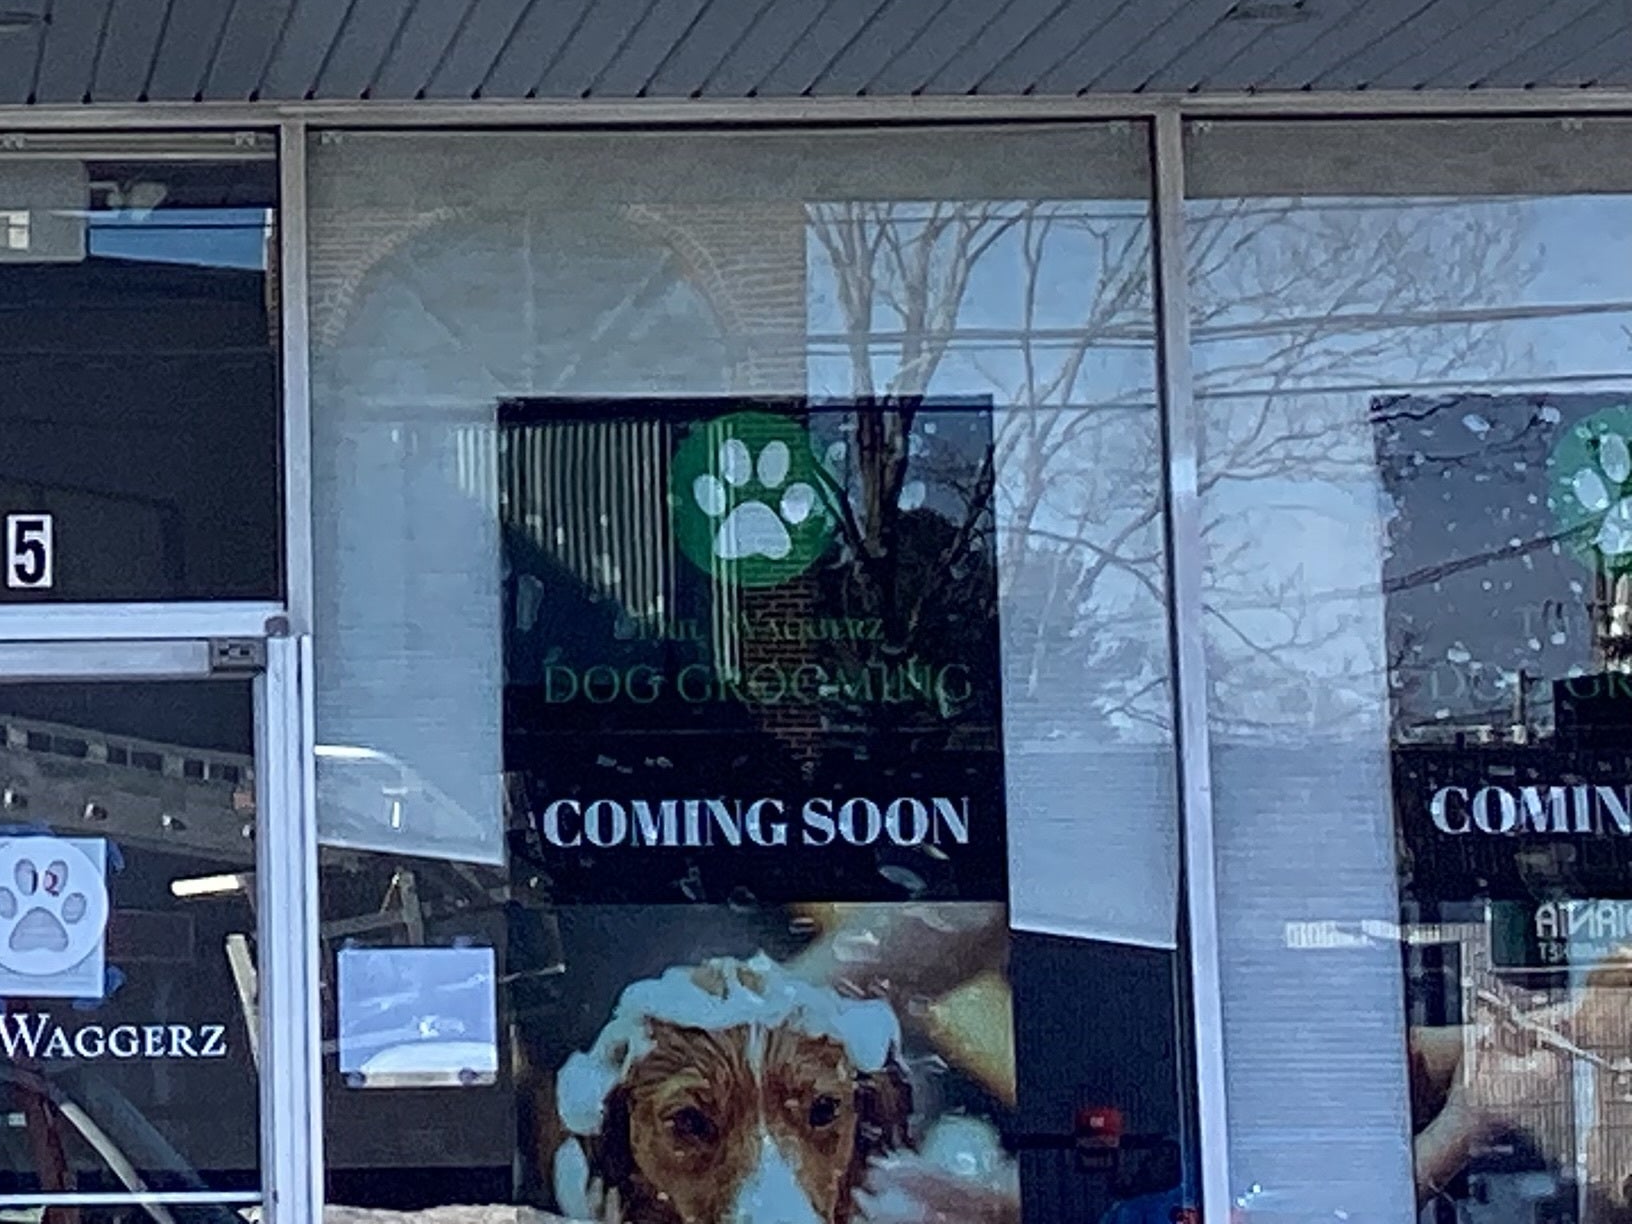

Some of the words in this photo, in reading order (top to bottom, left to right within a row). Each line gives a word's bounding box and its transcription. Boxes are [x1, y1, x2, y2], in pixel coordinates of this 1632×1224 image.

[13, 520, 46, 584] 5
[544, 663, 661, 704] DOG
[677, 662, 972, 704] GROOMING
[543, 797, 788, 847] COMING
[801, 796, 969, 846] SOON
[1430, 784, 1632, 835] COMIN
